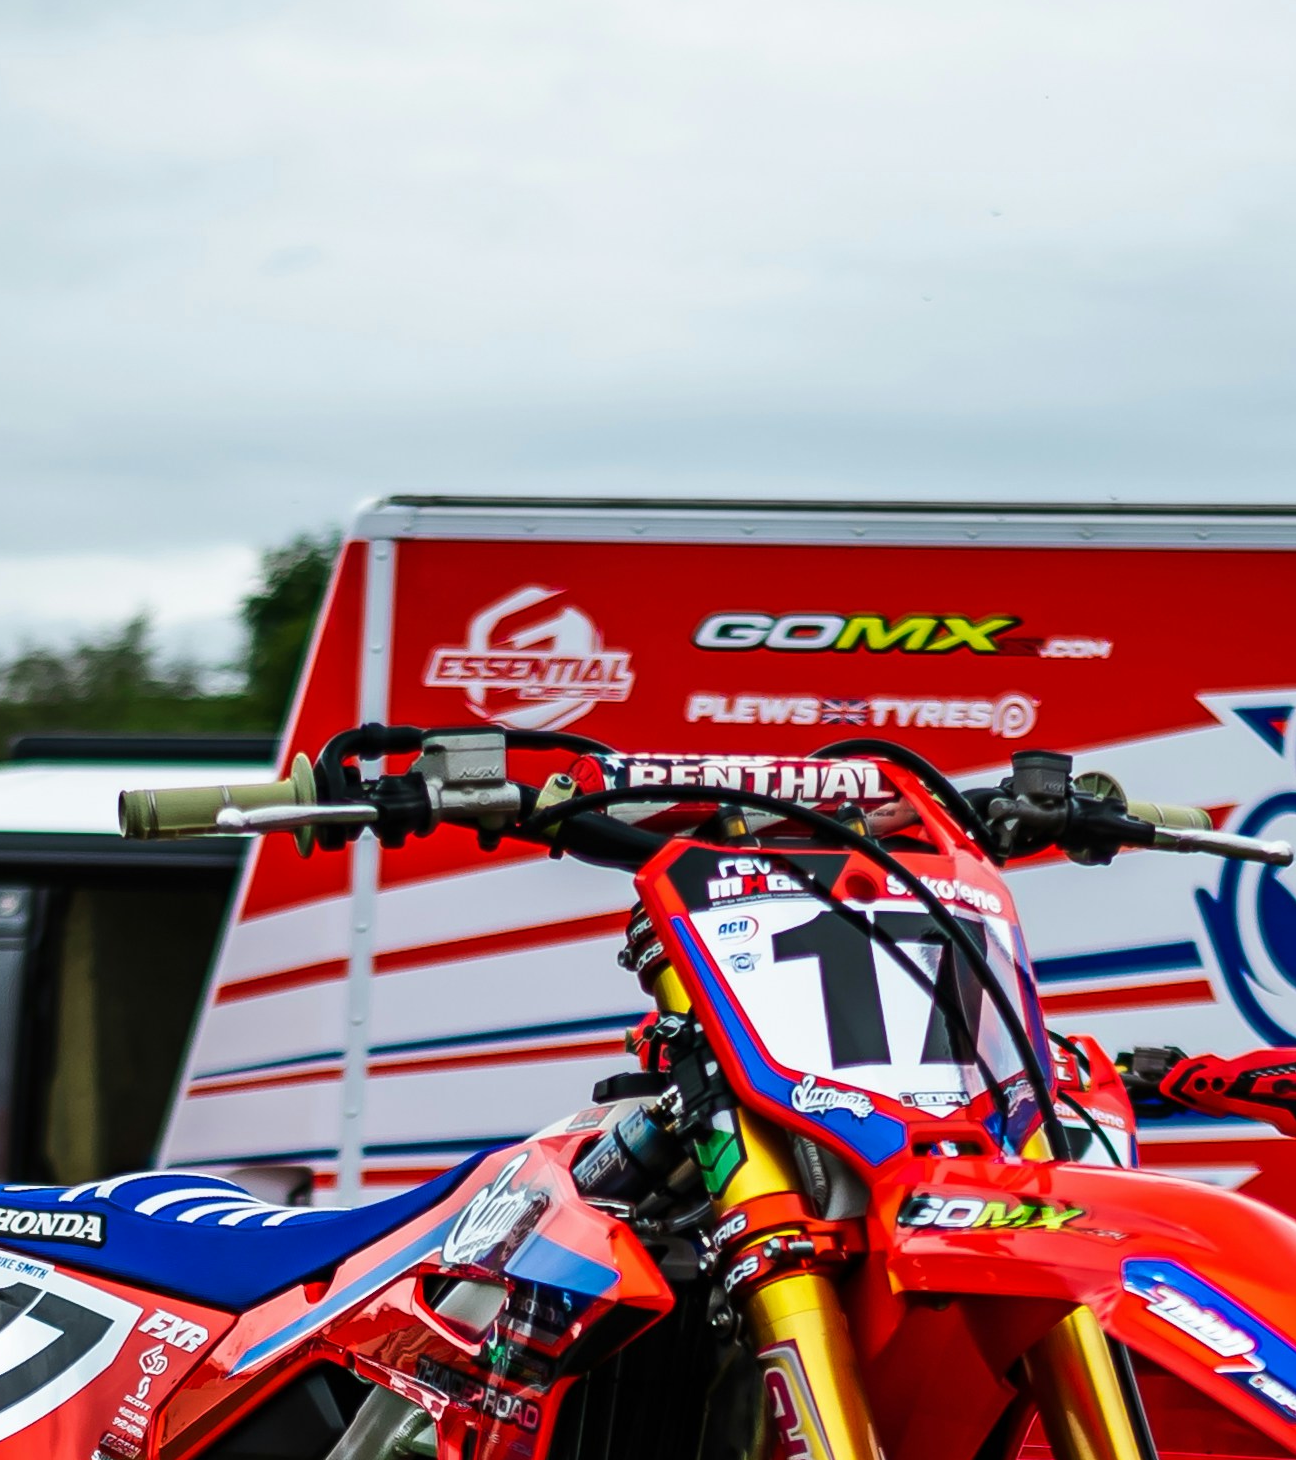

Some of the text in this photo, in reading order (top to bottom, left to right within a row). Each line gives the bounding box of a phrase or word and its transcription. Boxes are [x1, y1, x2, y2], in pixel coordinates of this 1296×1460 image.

[686, 694, 997, 729] PLEWS TYRES
[629, 764, 896, 800] RENTHAL
[718, 920, 749, 936] ACU
[771, 910, 987, 1070] 17
[16, 1262, 50, 1280] SMITH
[138, 1308, 209, 1354] FXR
[123, 1395, 152, 1412] SCOTT
